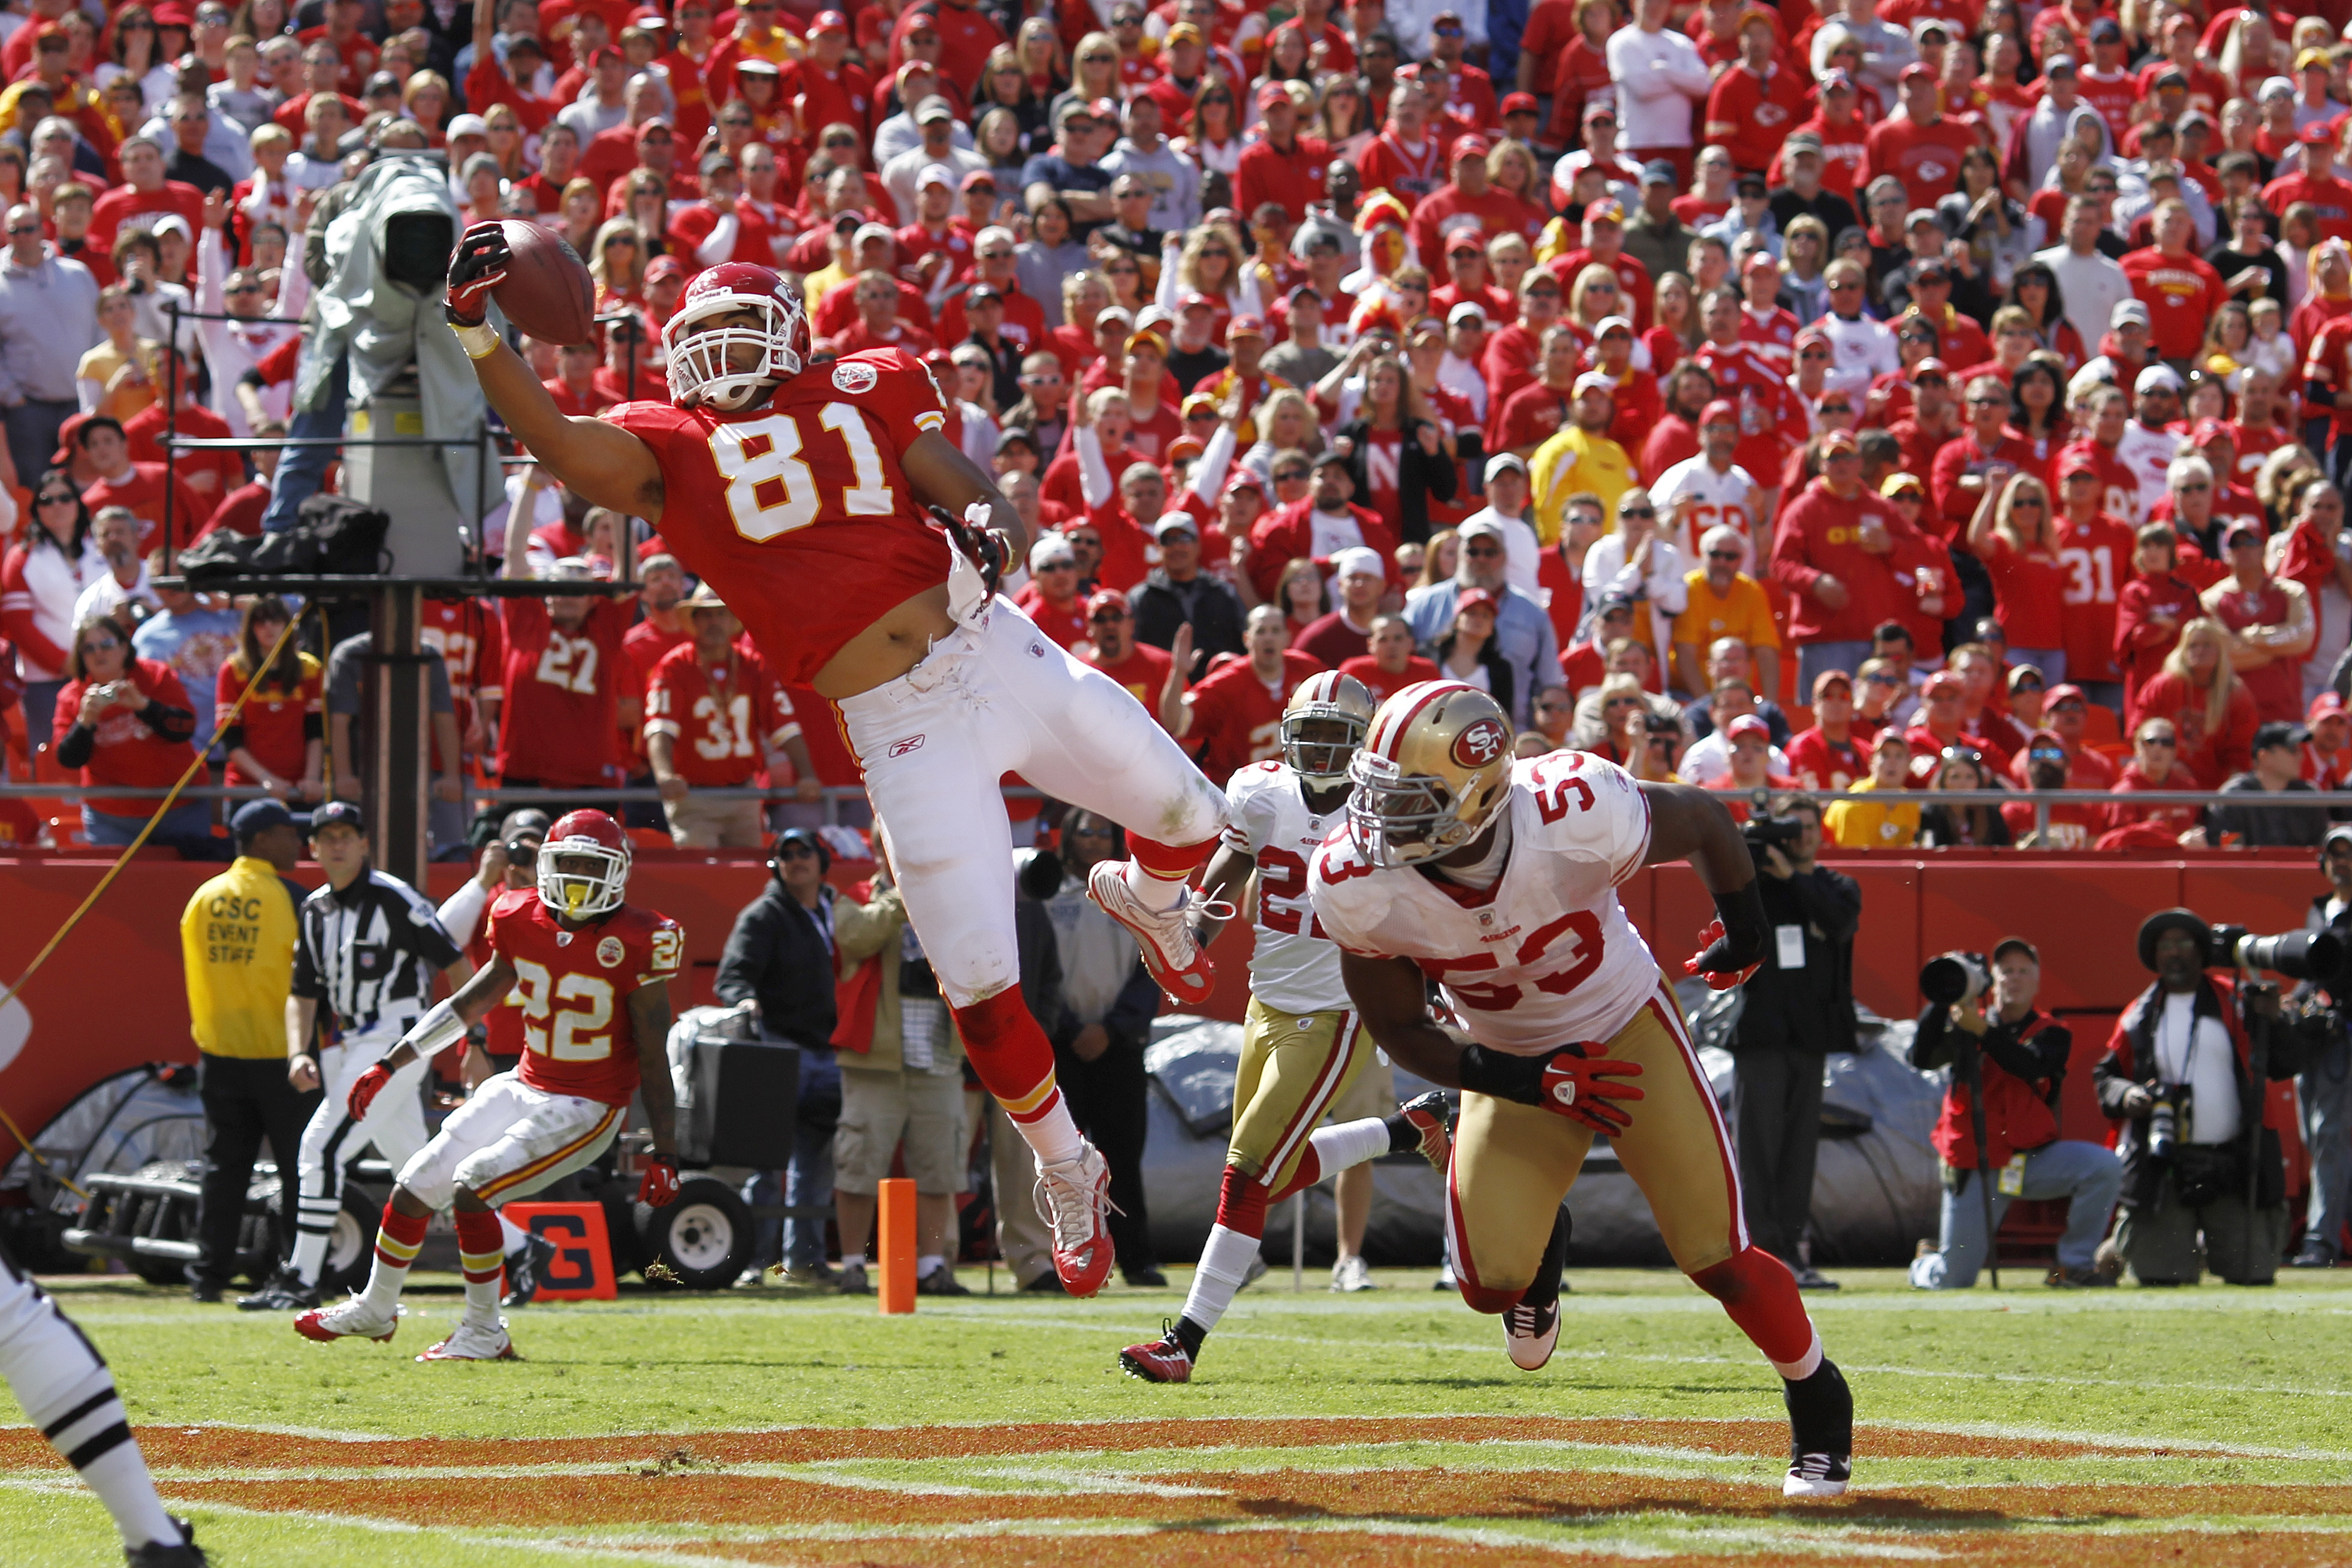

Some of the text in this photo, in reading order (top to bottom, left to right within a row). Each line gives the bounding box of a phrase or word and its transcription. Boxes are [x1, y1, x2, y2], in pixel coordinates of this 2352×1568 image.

[707, 401, 895, 544] 81
[1366, 441, 1403, 491] N
[2058, 546, 2116, 605] 31
[535, 629, 599, 695] 27
[646, 688, 672, 716] 31
[692, 694, 755, 761] 31
[1466, 724, 1501, 762] SF
[1530, 751, 1596, 826] 53
[210, 895, 261, 921] CSC
[1257, 845, 1331, 939] 2
[207, 922, 260, 944] EVENT
[1416, 909, 1606, 1012] 53
[512, 956, 615, 1062] 22
[529, 1214, 595, 1290] G
